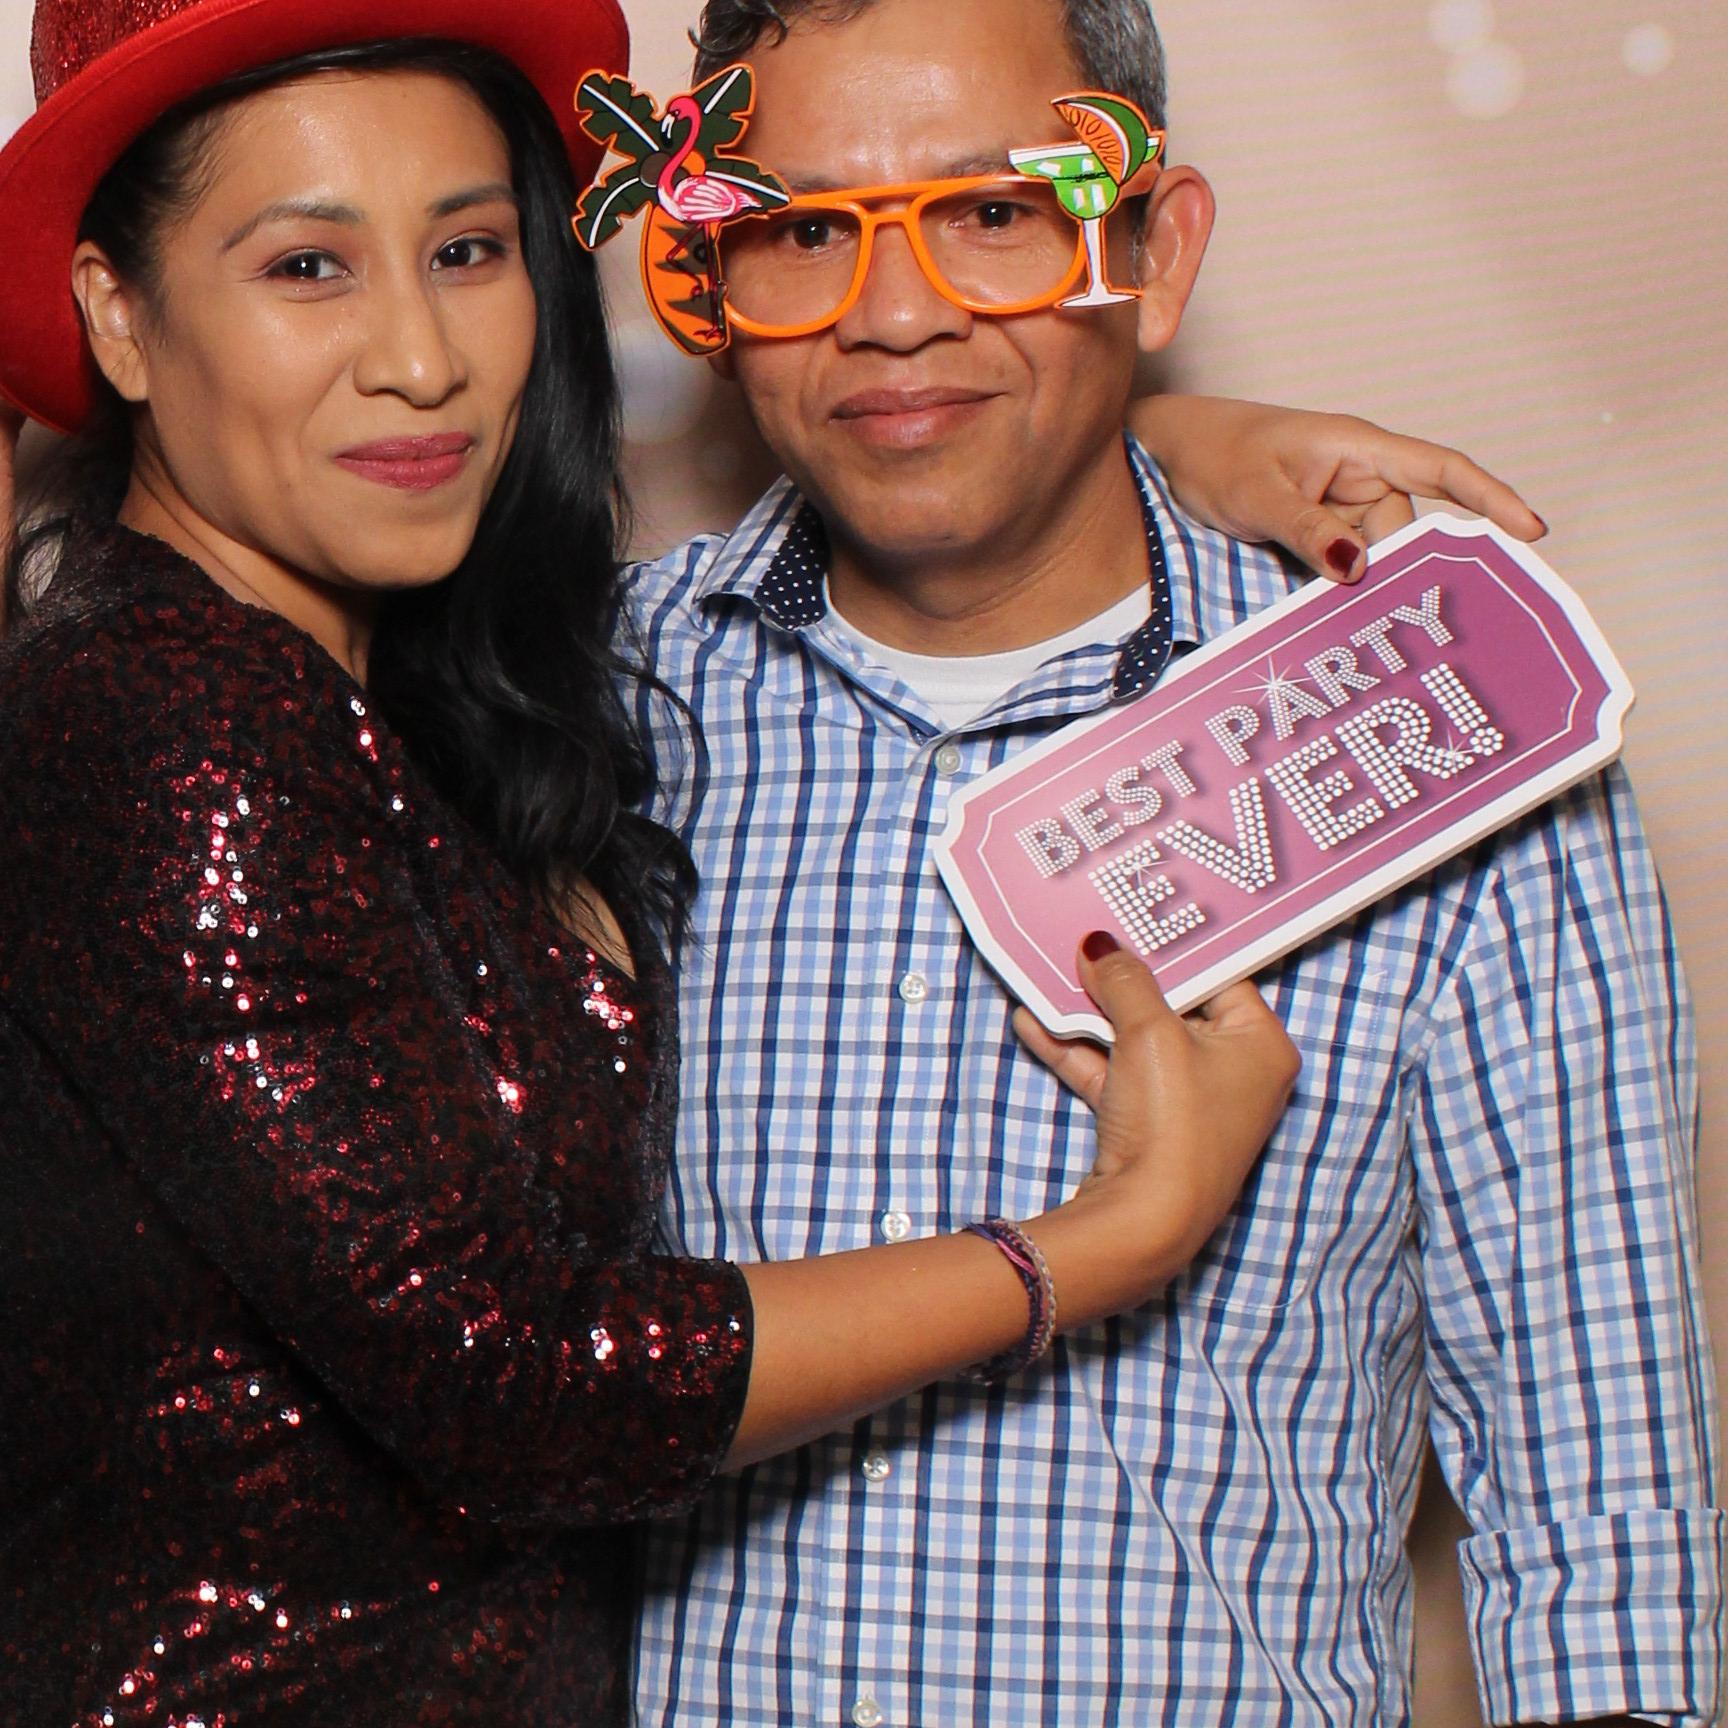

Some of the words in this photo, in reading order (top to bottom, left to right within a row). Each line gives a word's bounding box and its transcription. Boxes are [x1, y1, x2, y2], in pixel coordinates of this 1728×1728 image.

[1015, 740, 1197, 878] BEST
[1204, 584, 1453, 766] PARTY
[1088, 663, 1505, 956] EVER!
